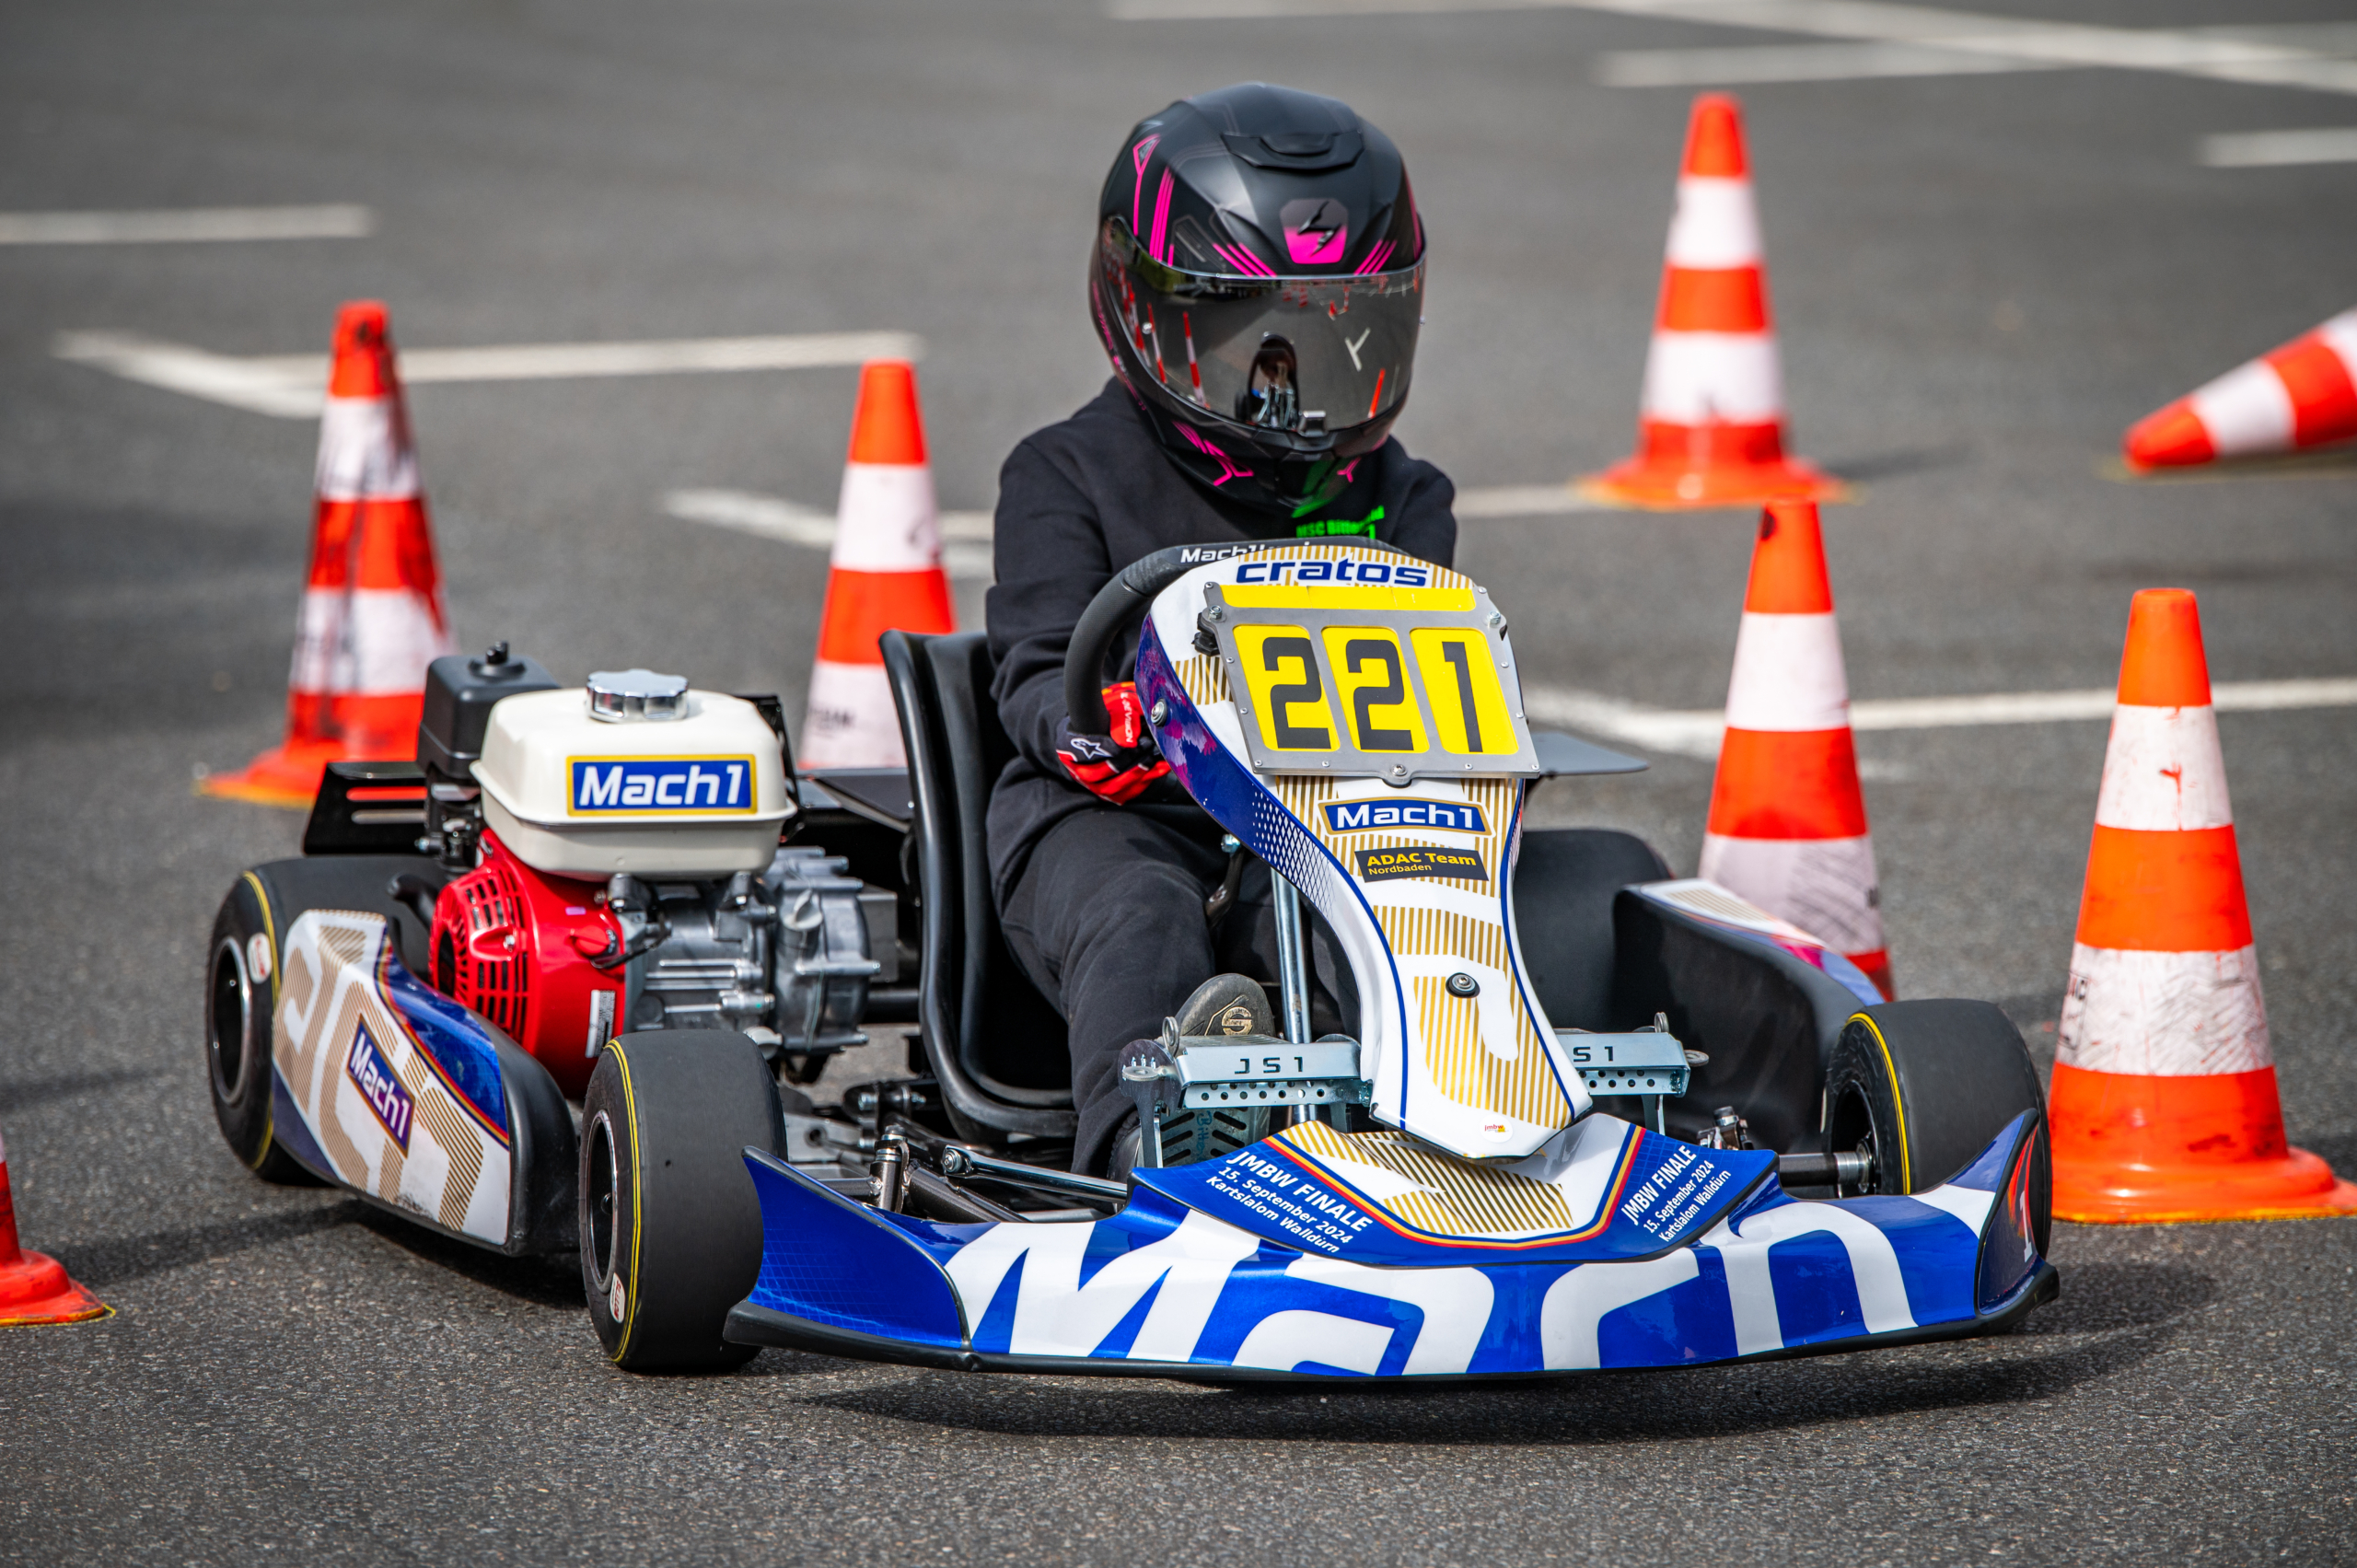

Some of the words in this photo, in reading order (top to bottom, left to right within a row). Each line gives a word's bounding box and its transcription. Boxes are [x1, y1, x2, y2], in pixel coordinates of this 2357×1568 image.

[1236, 558, 1427, 587] cratos
[1261, 636, 1483, 753] 221
[579, 764, 743, 806] Mach1
[1337, 804, 1472, 829] Mach1
[1367, 853, 1422, 866] ADAC
[1424, 853, 1476, 865] Team
[1368, 864, 1432, 875] Nordbaden
[349, 1030, 411, 1140] Mach1
[1206, 1176, 1280, 1221] Kartslalom
[1279, 1216, 1340, 1253] Walldürn
[1218, 1167, 1240, 1183] 15.
[1242, 1179, 1318, 1224] September
[1316, 1221, 1353, 1244] 2024
[1226, 1151, 1298, 1188] JMBW
[1293, 1183, 1373, 1232] FINALE
[1621, 1181, 1659, 1225] JMBW
[1651, 1144, 1697, 1190] FINALE
[1643, 1219, 1660, 1234] 15.
[1655, 1179, 1697, 1223] September
[1691, 1160, 1714, 1183] 2024
[1658, 1203, 1700, 1242] Kartslalom
[1693, 1170, 1731, 1206] Walldürn
